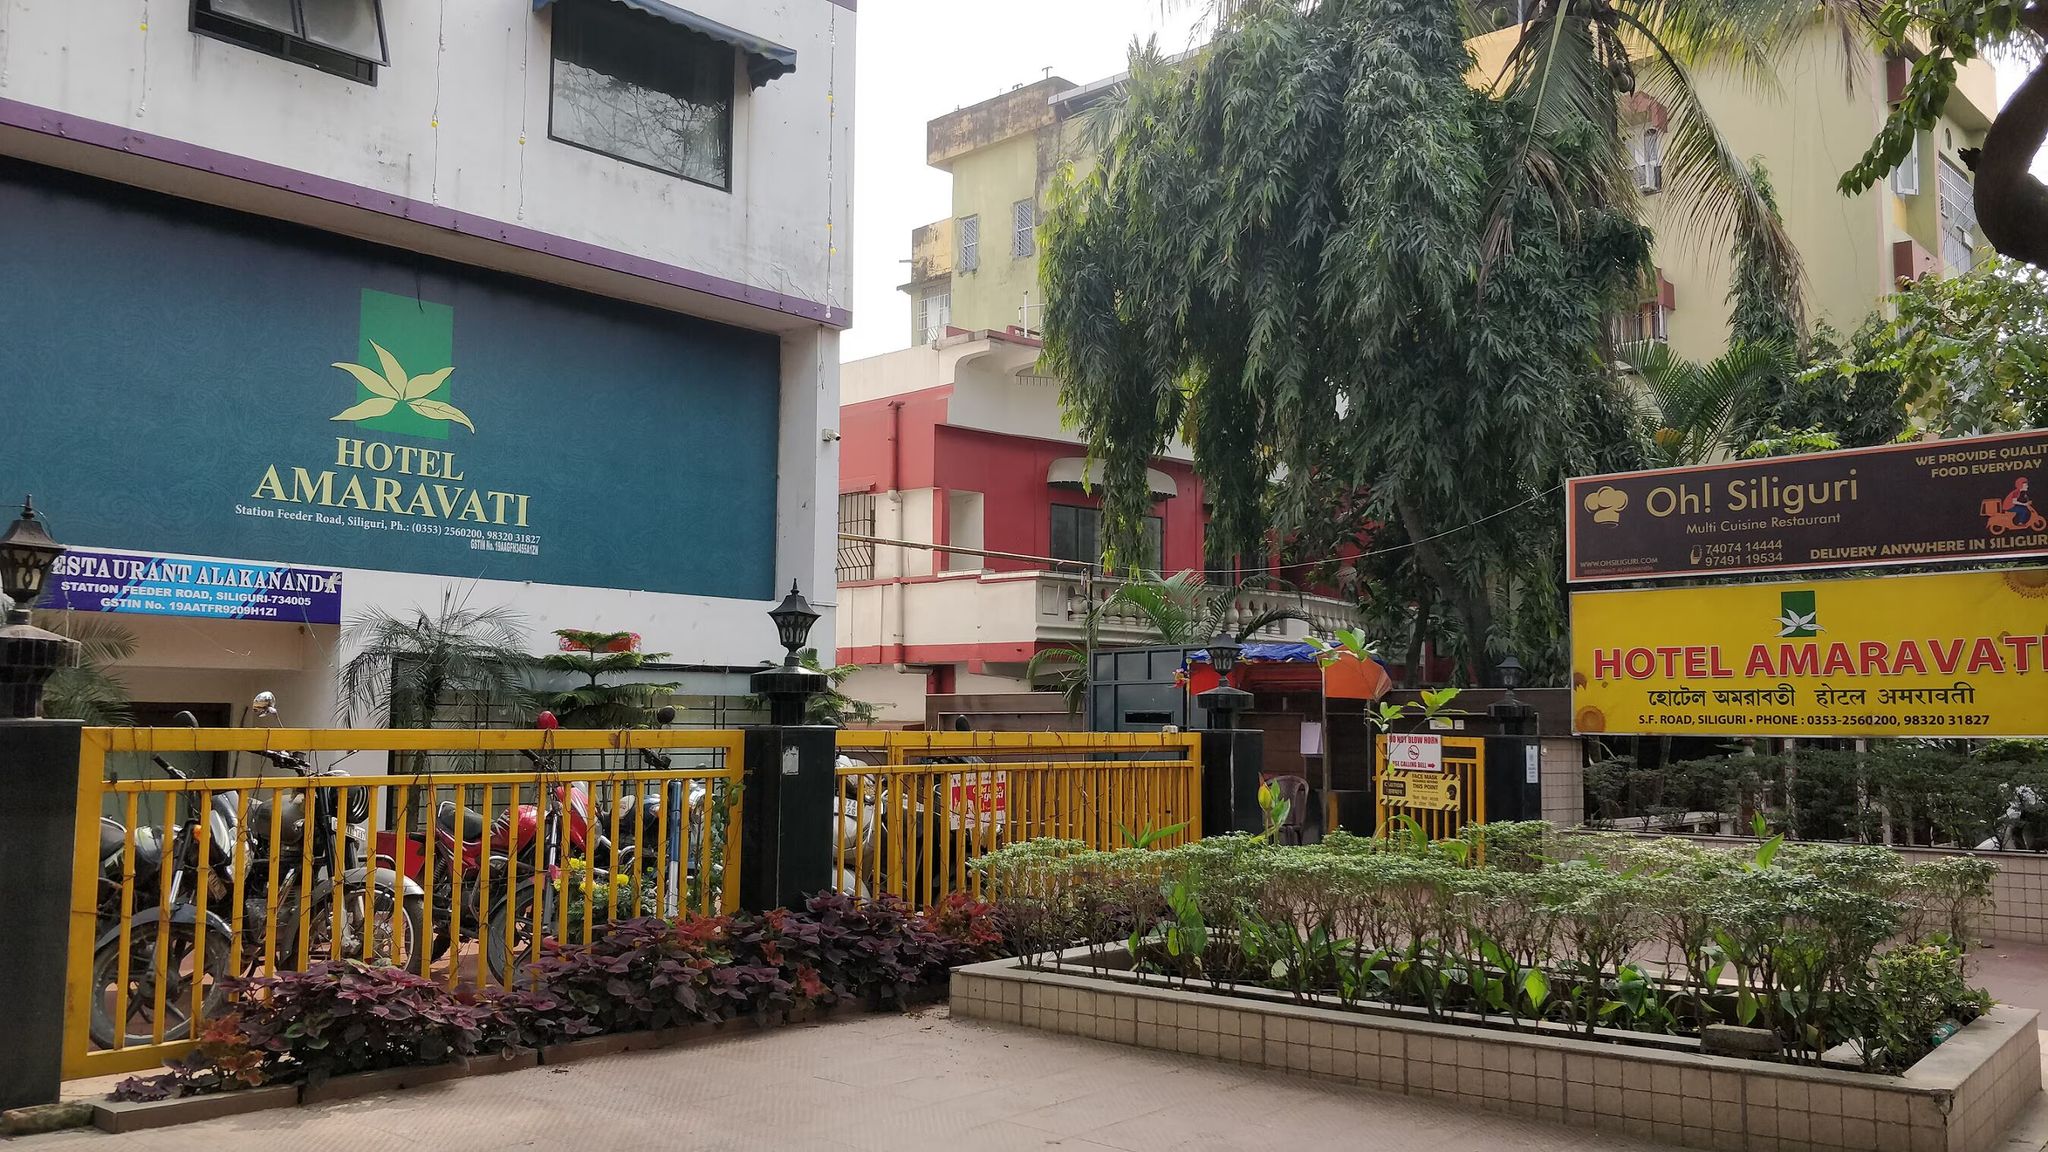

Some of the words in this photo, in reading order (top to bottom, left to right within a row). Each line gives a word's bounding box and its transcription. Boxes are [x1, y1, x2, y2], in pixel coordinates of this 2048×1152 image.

[335, 437, 464, 481] HOTEL
[1916, 455, 1936, 466] WE
[1939, 450, 1997, 465] PROVIDE
[2000, 445, 2048, 460] QUALIT
[1931, 466, 1969, 478] FOOD
[1972, 459, 2043, 475] EVERYDAY
[251, 463, 531, 527] AMARAVATI
[1646, 482, 1711, 518] Oh!
[1727, 469, 1858, 515] Siliguri
[235, 504, 274, 518] Station
[277, 508, 313, 522] Feeder
[315, 512, 345, 526] Road,
[347, 516, 388, 530] Siliguri,
[411, 522, 442, 535] (0353)
[444, 526, 485, 539] 2560200,
[487, 531, 514, 542] 98320
[515, 533, 541, 545] 31827
[1686, 521, 1717, 535] Multi
[1720, 518, 1767, 532] Cuisine
[1772, 513, 1841, 528] Restaurant
[470, 538, 487, 550] GSTIN
[1706, 543, 1743, 555] 74074
[1745, 539, 1783, 552] 14444
[1810, 545, 1878, 560] DELIVERY
[1880, 539, 1966, 555] ANYWHERE
[1969, 538, 1986, 551] IN
[1989, 534, 2048, 550] SILIGUR
[1579, 557, 1658, 569] WWW.OHSILIGURI.COM
[1706, 554, 1741, 567] 97491
[1745, 552, 1783, 564] 19534
[51, 555, 192, 583] ESTAURANT
[196, 566, 338, 594] ALAKANANDA
[61, 581, 119, 594] STATION
[122, 585, 172, 597] FEEDER
[175, 588, 213, 601] ROAD,
[216, 590, 312, 606] SILIGURI-734005
[100, 597, 141, 609] GSTIN
[145, 600, 166, 610] No.
[169, 602, 277, 617] 19AATFR9209H1ZI
[1593, 646, 1734, 680] HOTEL
[1744, 635, 2048, 677] AMARAVATI
[1647, 685, 1707, 706] হোটেল
[1712, 683, 1796, 707] অমরাবতী
[1814, 683, 1867, 709] होटल
[1877, 681, 1975, 705] अमरावती
[1638, 714, 1658, 725] S.F.
[1660, 714, 1695, 726] ROAD,
[1698, 714, 1746, 725] SILIGURI
[1756, 714, 1798, 725] PHONE
[1807, 714, 1901, 727] 0353-2560200,
[1904, 714, 1944, 725] 98320
[1948, 714, 1990, 725] 31827
[1408, 736, 1424, 744] BLOW
[1424, 736, 1438, 744] HORN
